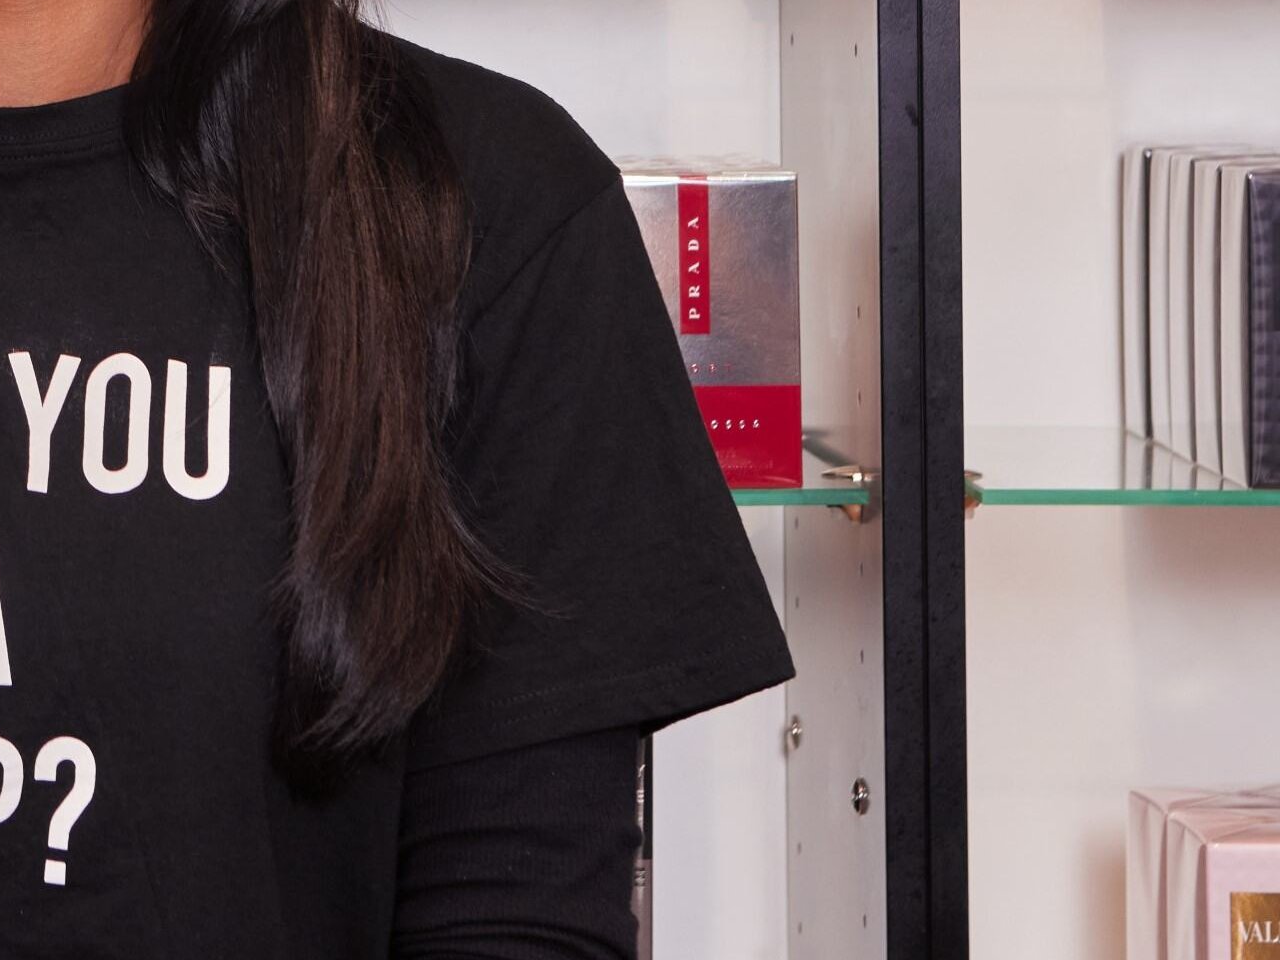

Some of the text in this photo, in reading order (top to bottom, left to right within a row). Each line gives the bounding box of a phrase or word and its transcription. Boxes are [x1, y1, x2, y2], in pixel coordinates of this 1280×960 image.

[687, 216, 701, 320] PRADA
[8, 352, 231, 500] YOU
[1237, 920, 1280, 943] VAL
